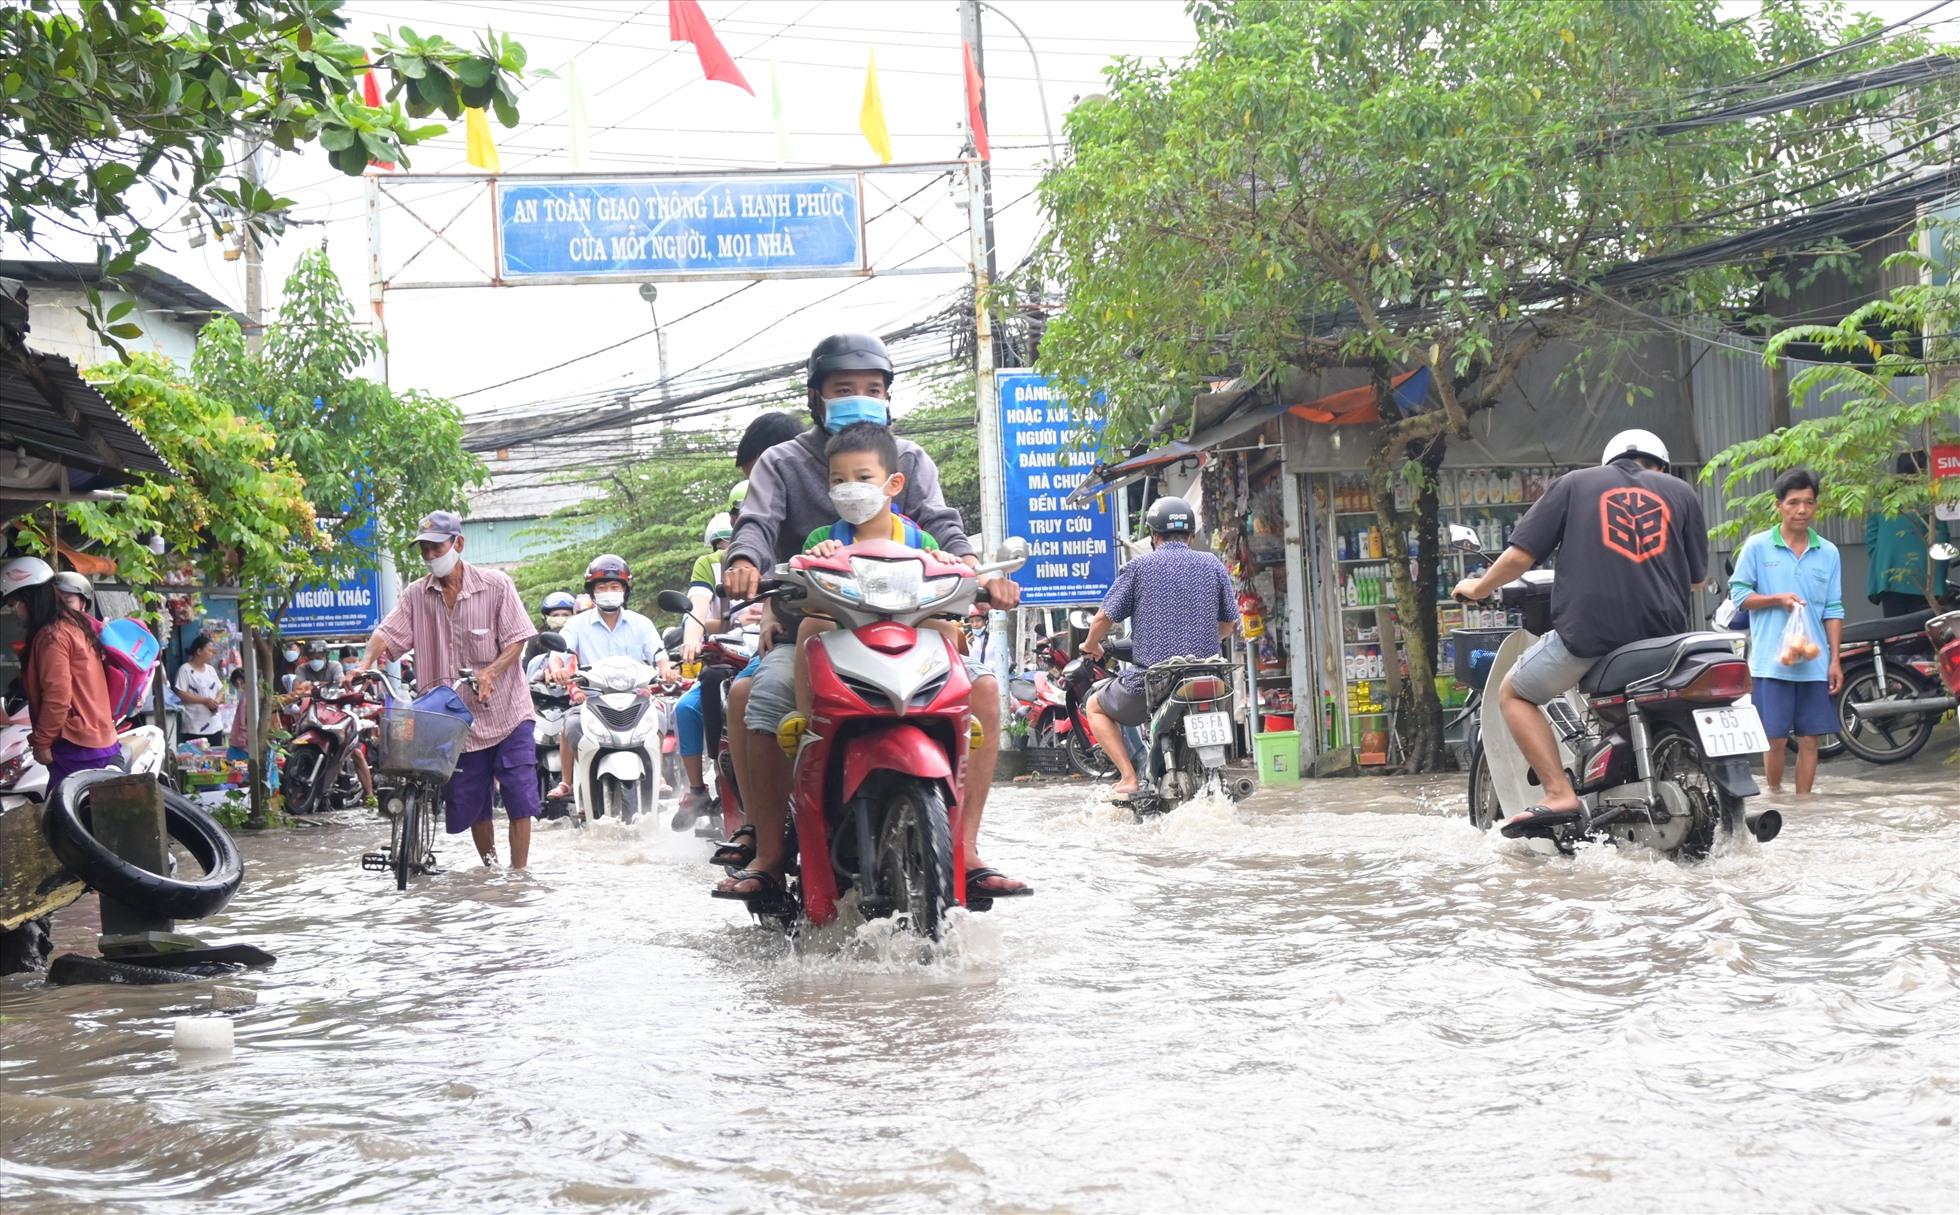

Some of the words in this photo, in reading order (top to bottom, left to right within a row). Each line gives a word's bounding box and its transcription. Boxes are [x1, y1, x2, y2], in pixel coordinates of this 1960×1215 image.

[513, 198, 538, 223] AN
[543, 191, 591, 222] TOÀN
[597, 196, 640, 221] GIAO
[644, 189, 707, 220] THÔNG
[712, 188, 736, 218] LÀ
[741, 193, 792, 223] HẠNH
[796, 185, 844, 216] PHÚC
[651, 228, 712, 261] NGƯỜI,
[717, 234, 752, 262] MỌI
[756, 226, 796, 257] NHÀ
[1007, 406, 1042, 426] HOẶC
[1016, 428, 1057, 446] NGƯỜI
[1019, 450, 1056, 467] ĐÁNH
[1060, 451, 1095, 467] HAU
[1028, 472, 1050, 490] MÀ
[1029, 493, 1057, 512] ĐẾN
[1028, 519, 1062, 534] TRUY
[1065, 516, 1092, 533] CỨU
[1026, 540, 1059, 556] RÁCH
[1063, 537, 1107, 557] NHIỆM
[1036, 561, 1068, 578] HÌNH
[1072, 560, 1090, 579] SỰ
[296, 588, 334, 609] NGƯỜI
[337, 587, 371, 607] KHÁC
[1720, 709, 1739, 728] 65
[1193, 729, 1226, 744] 5983
